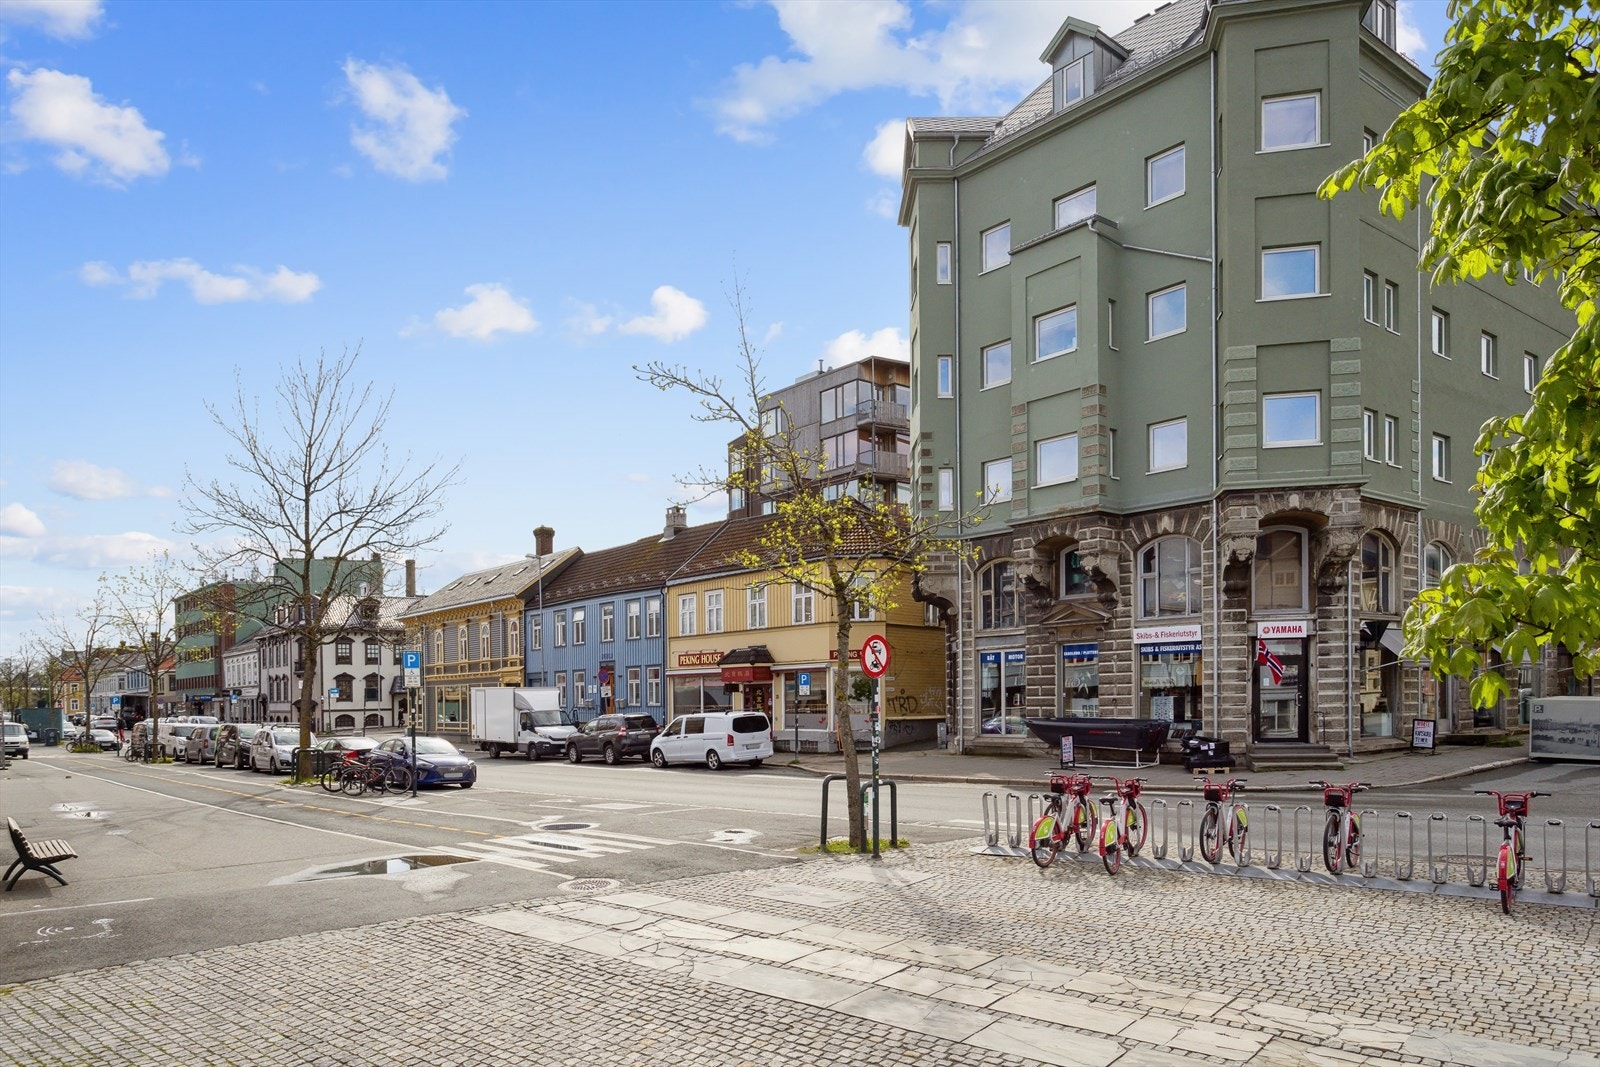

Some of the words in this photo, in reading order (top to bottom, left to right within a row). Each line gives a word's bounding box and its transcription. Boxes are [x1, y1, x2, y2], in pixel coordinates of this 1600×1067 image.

[1160, 629, 1198, 638] Fiskeriutstyr
[1271, 625, 1303, 634] YAMAHA
[1160, 644, 1195, 652] FISKERIUTSTYR
[407, 654, 416, 667] P
[679, 654, 700, 665] PEKING
[701, 653, 721, 664] HOUSE
[801, 674, 807, 684] P
